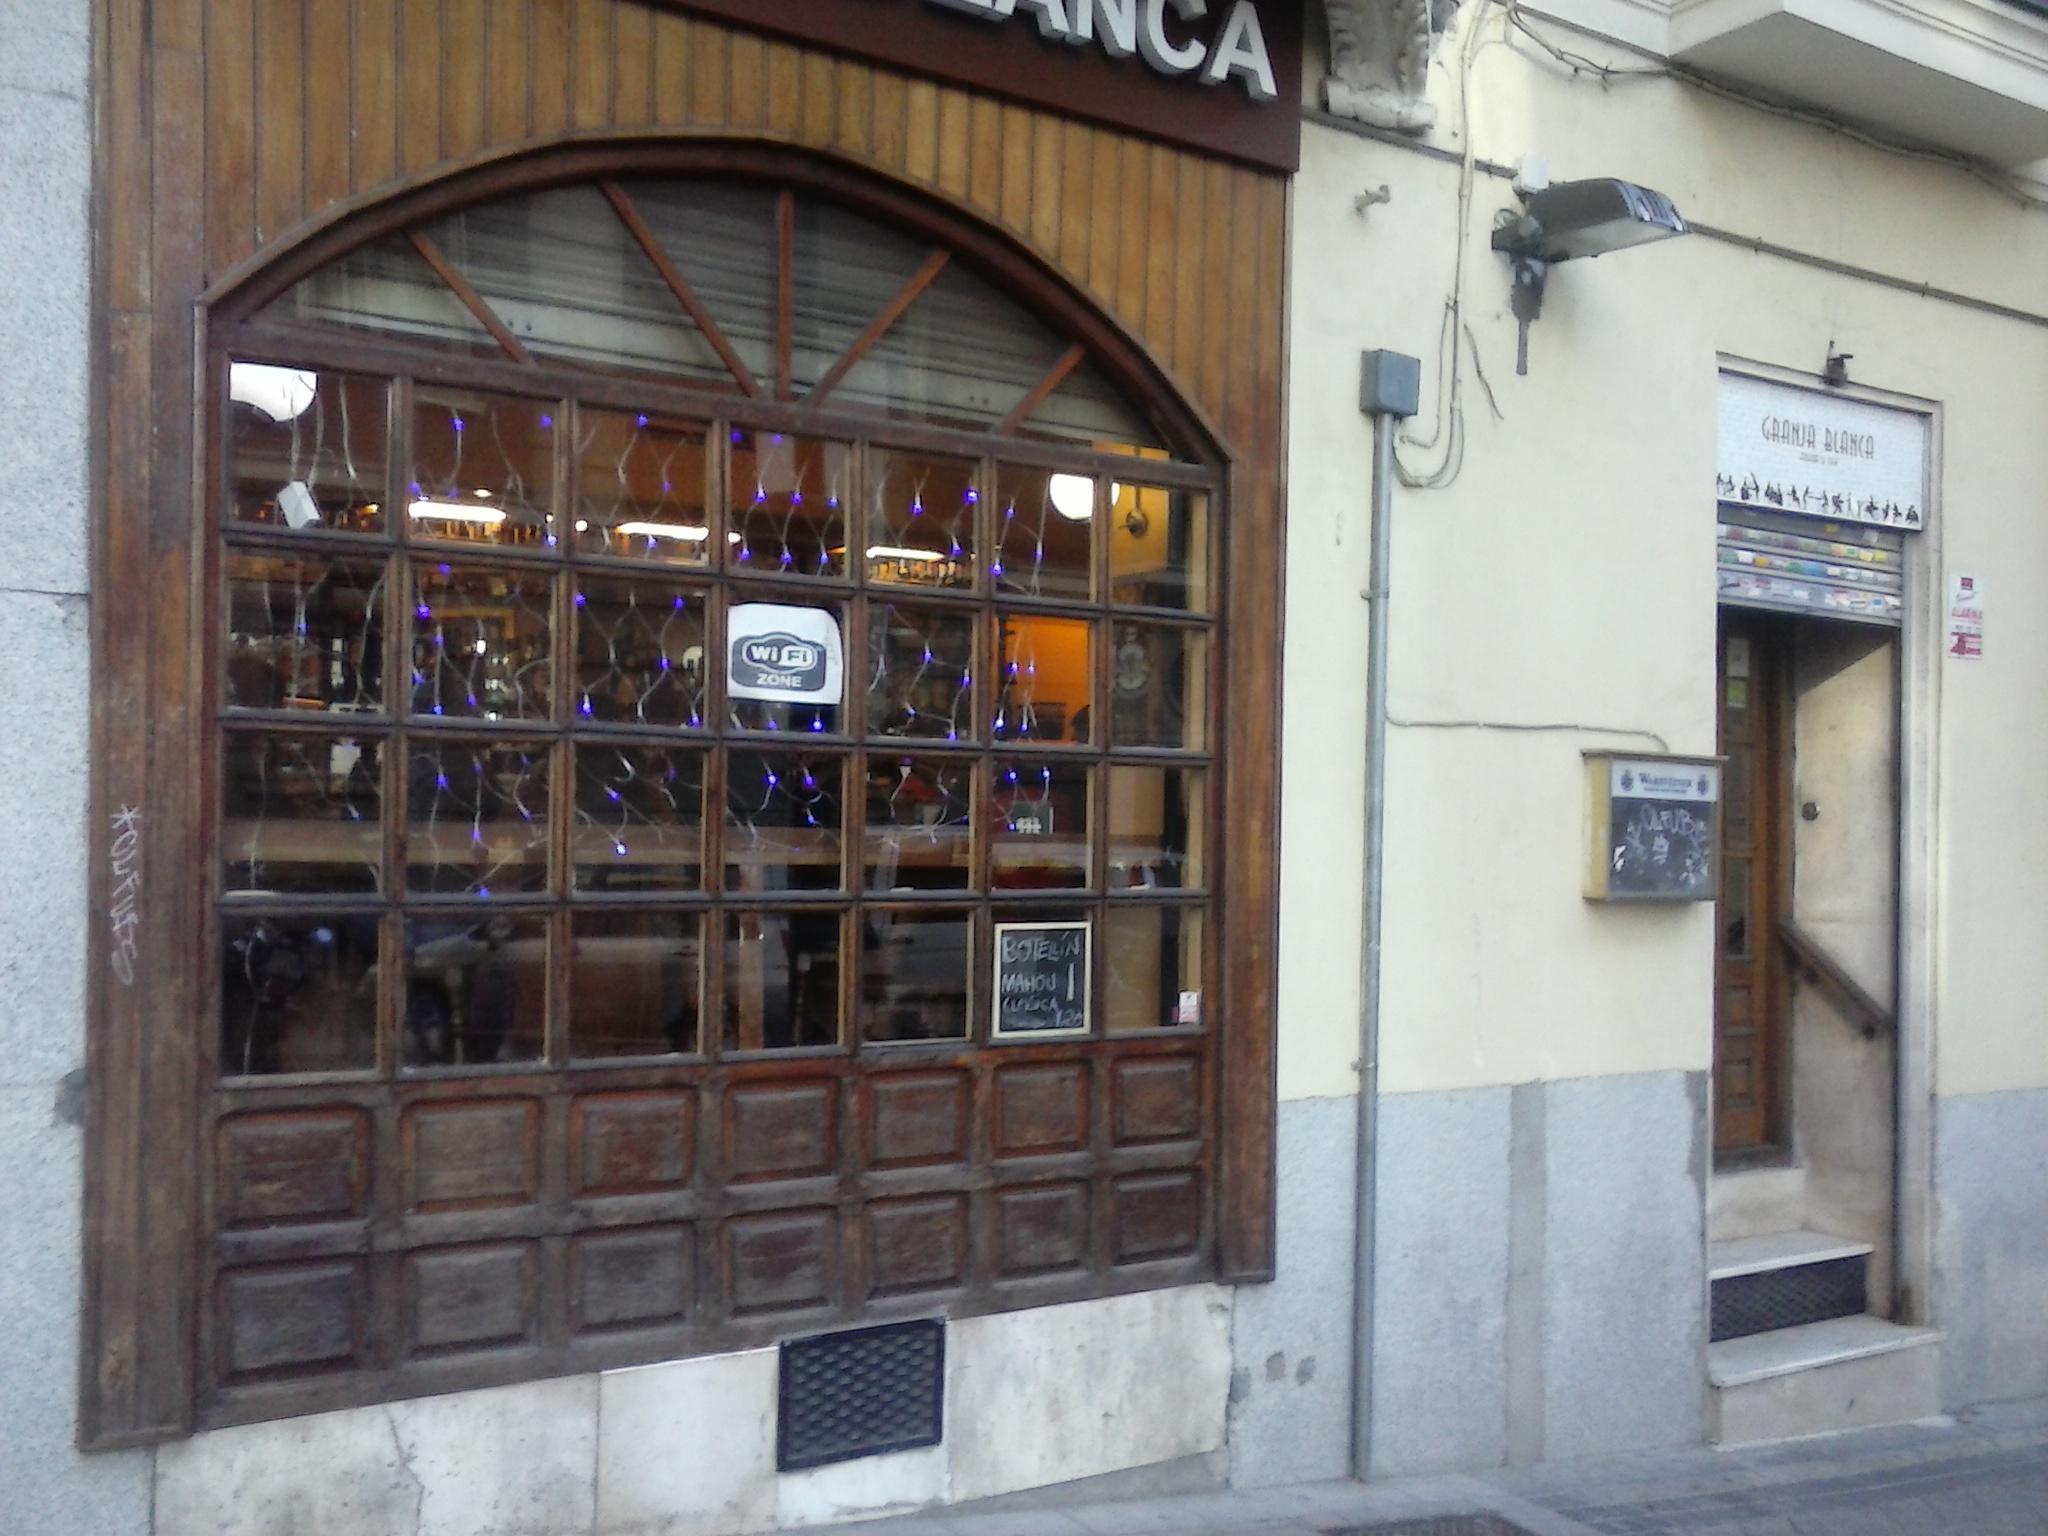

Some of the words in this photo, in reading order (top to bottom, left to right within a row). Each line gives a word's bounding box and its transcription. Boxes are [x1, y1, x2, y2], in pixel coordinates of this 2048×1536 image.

[1761, 415, 1817, 449] GRANJA
[1824, 426, 1875, 459] BLANCA
[756, 673, 803, 688] ZONE
[1001, 972, 1057, 994] MAHOU
